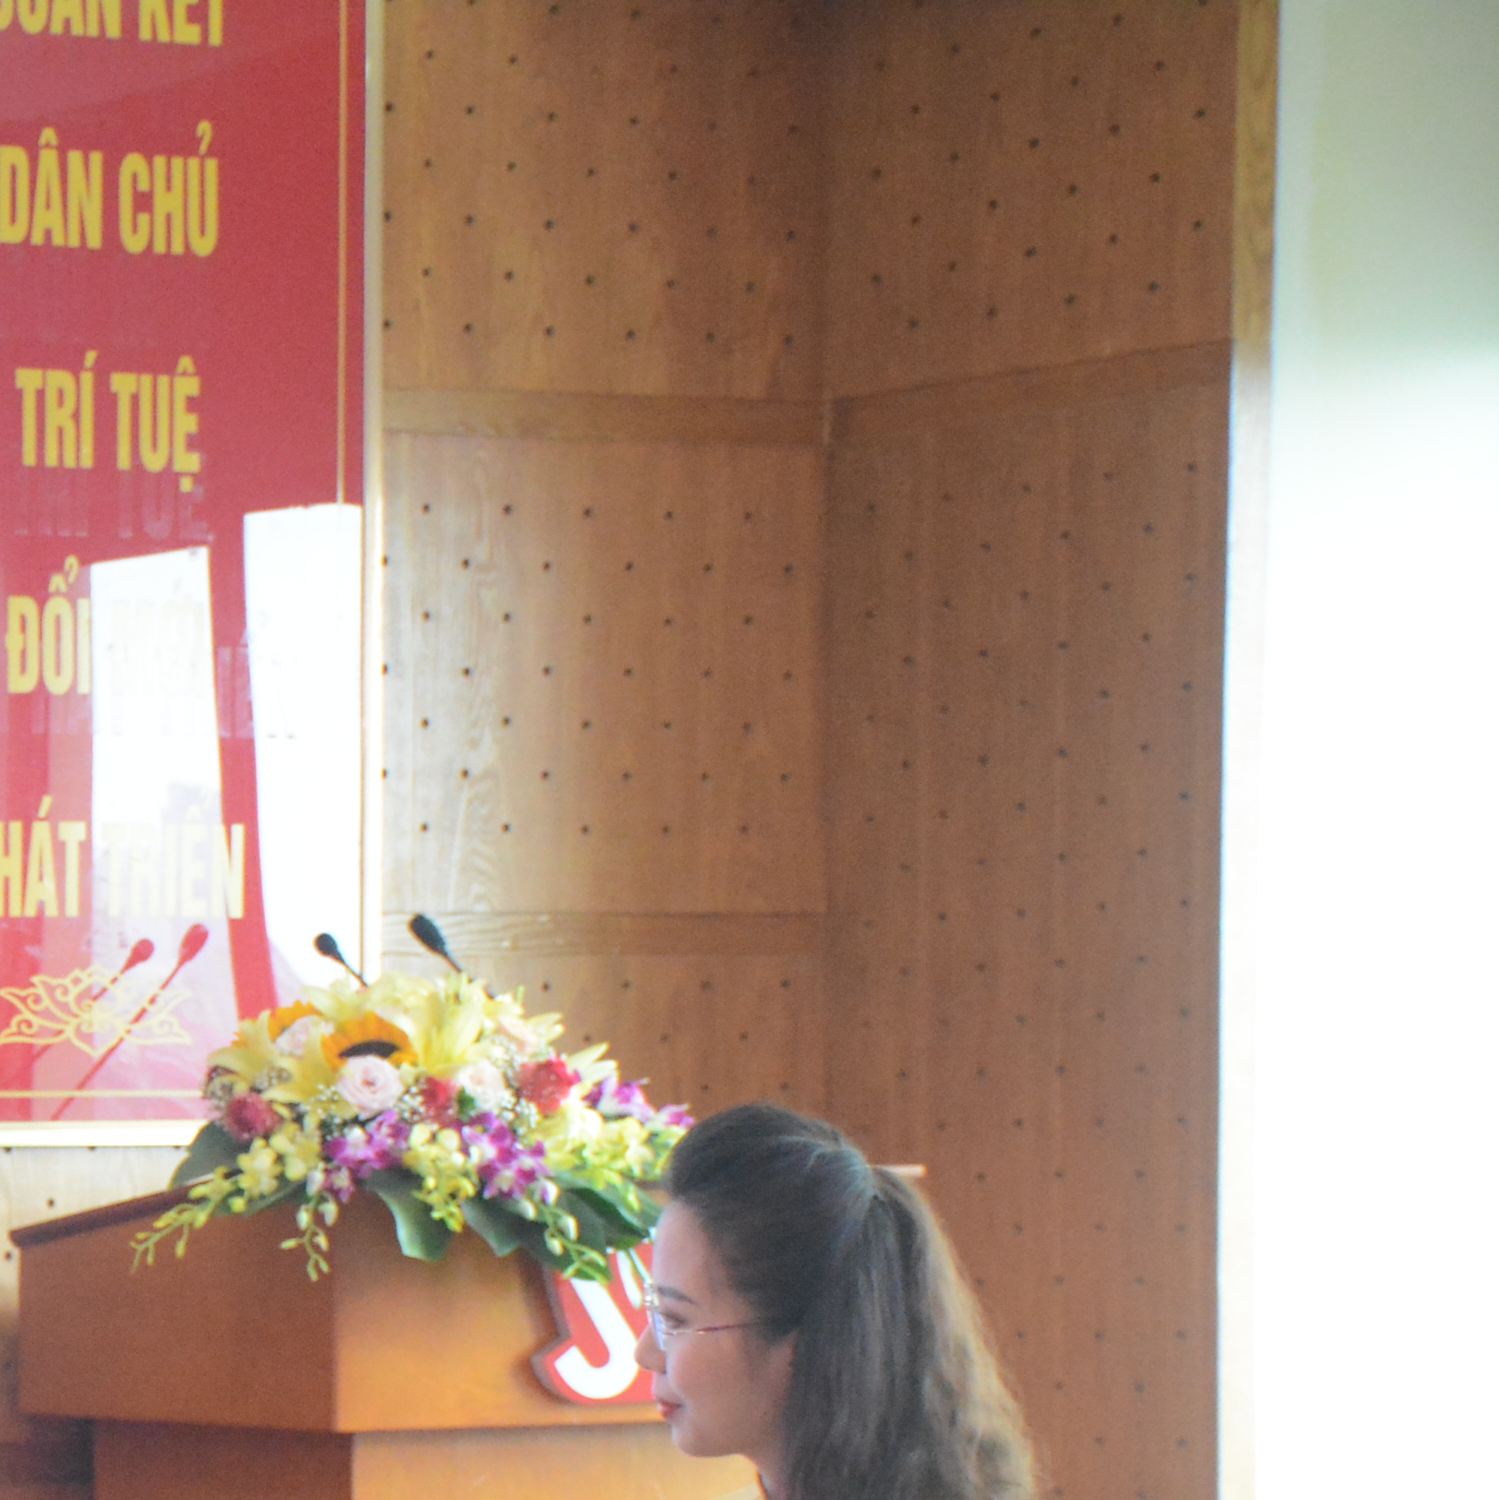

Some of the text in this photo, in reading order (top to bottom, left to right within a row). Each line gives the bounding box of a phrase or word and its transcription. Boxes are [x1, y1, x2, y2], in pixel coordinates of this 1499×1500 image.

[118, 120, 219, 257] CHỦ
[15, 350, 202, 493] TRÍ TUỆ
[5, 554, 91, 695] ĐỔI
